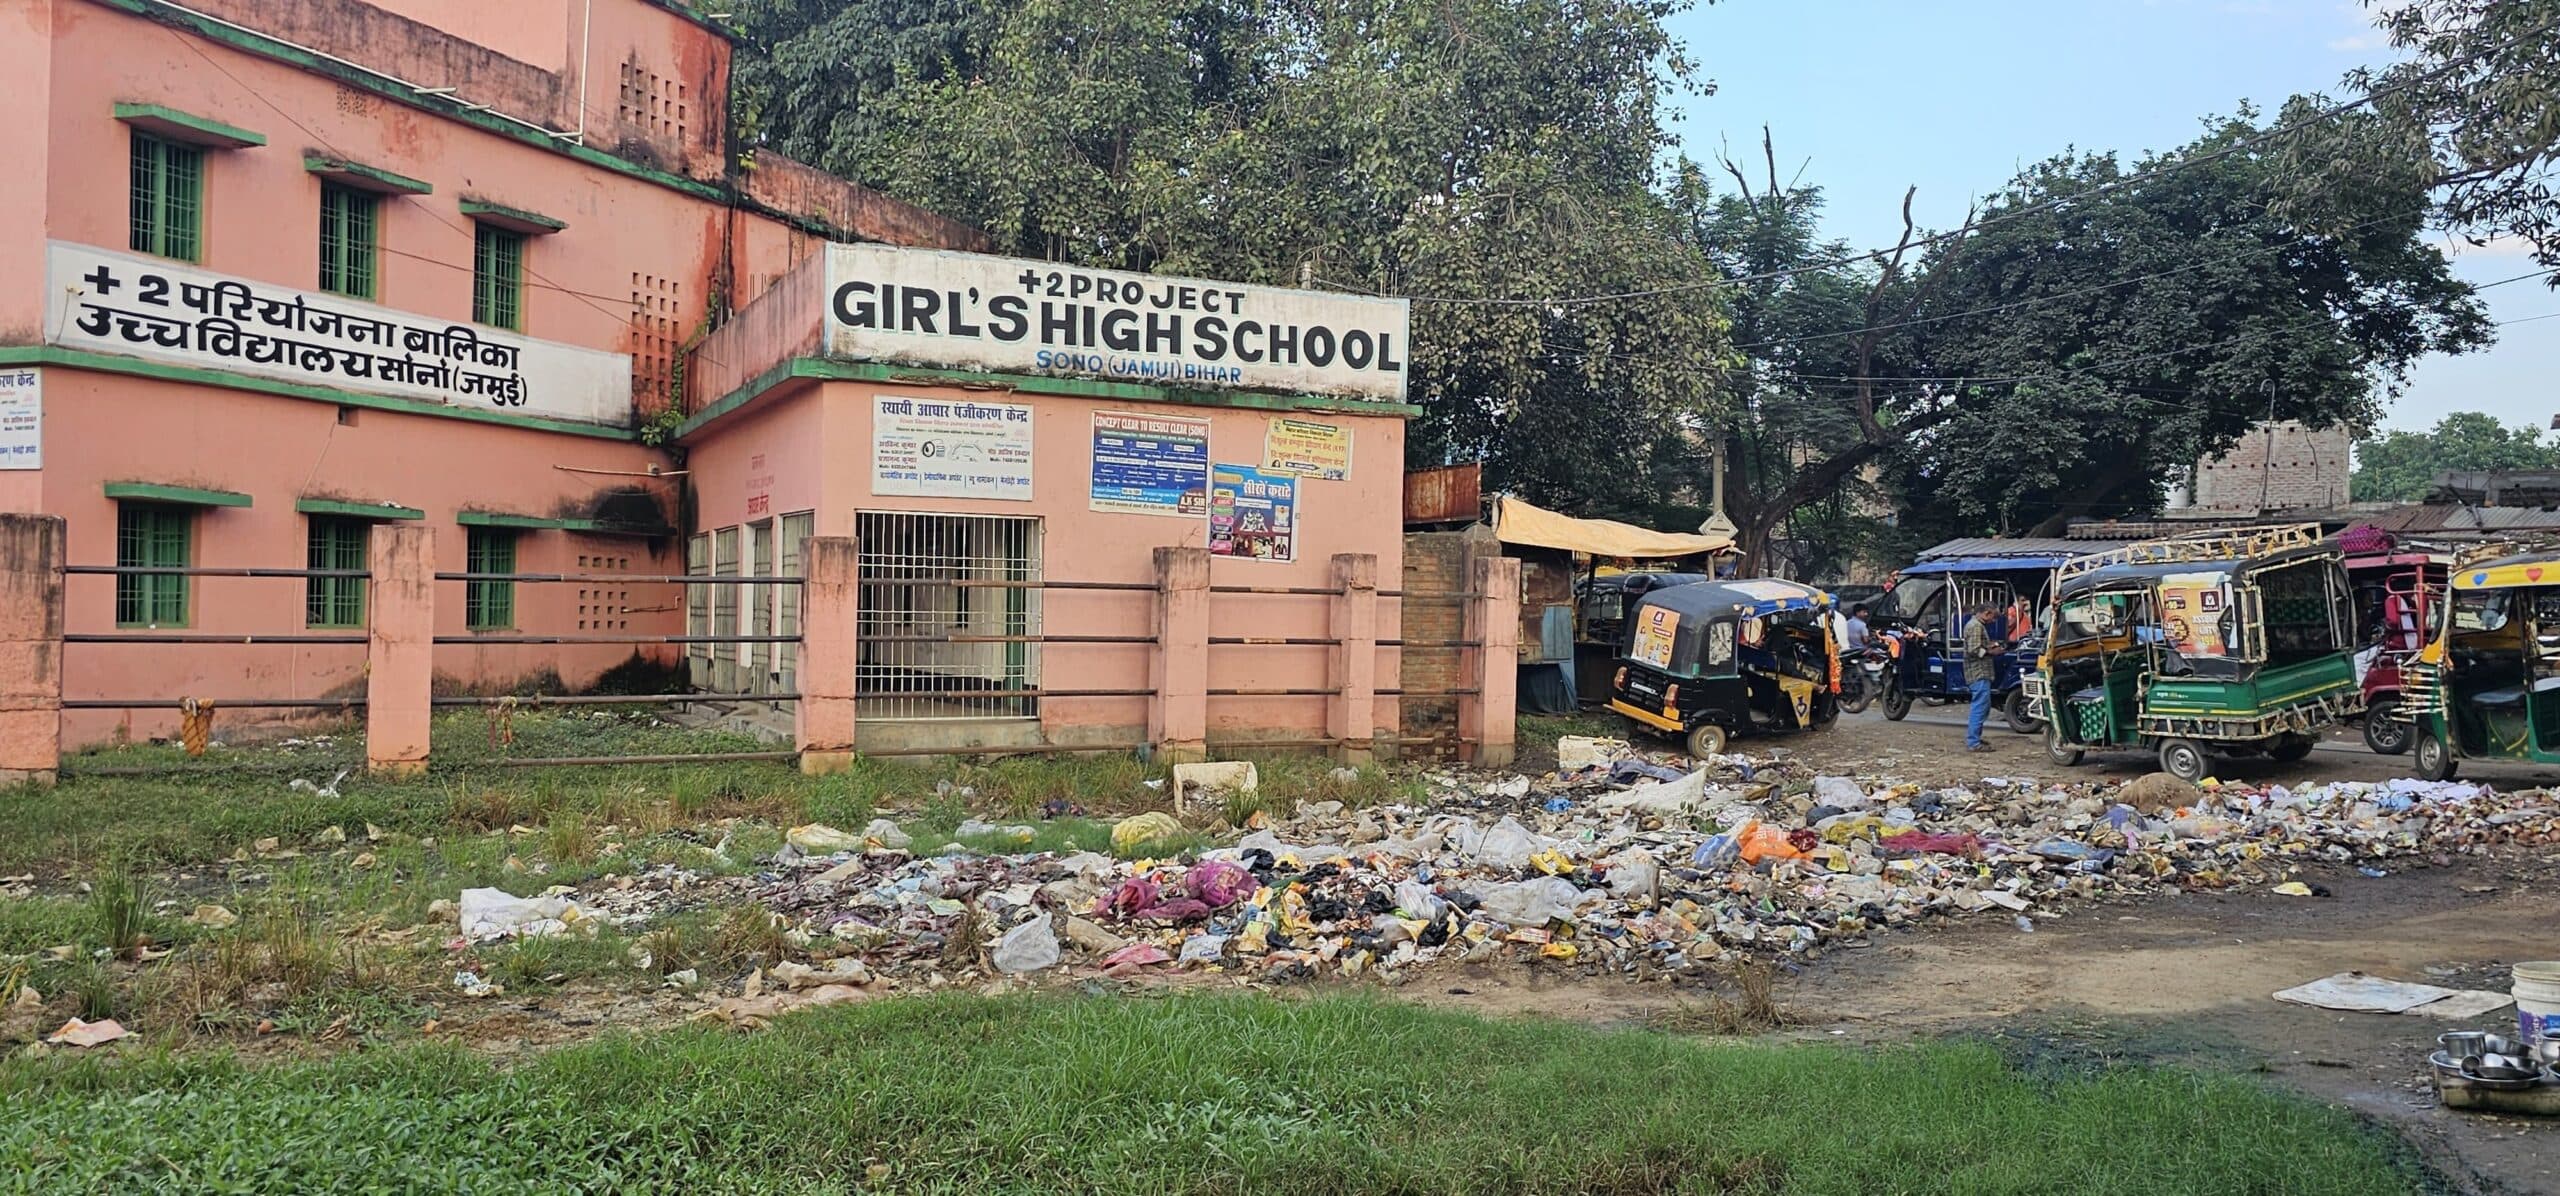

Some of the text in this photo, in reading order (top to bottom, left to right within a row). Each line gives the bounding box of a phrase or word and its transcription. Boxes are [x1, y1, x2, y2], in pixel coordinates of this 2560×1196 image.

[84, 265, 521, 370] + 2 परियोजना बालिका
[833, 281, 1401, 371] GIRL'S HIGH SCHOOL
[76, 303, 191, 349] उच्च
[196, 317, 374, 378] विद्यालय
[453, 366, 527, 406] (जमुई)
[1036, 350, 1103, 371] SONO
[1184, 364, 1241, 383] BIHAR
[954, 403, 1002, 421] पंजीकरण
[1005, 406, 1028, 423] केन्द्र
[1095, 416, 1120, 428] CONCEPT
[1121, 418, 1139, 430] CLEAR
[1140, 420, 1148, 431] TO
[1149, 421, 1169, 433] RESULT
[1170, 422, 1187, 435] CLEAR
